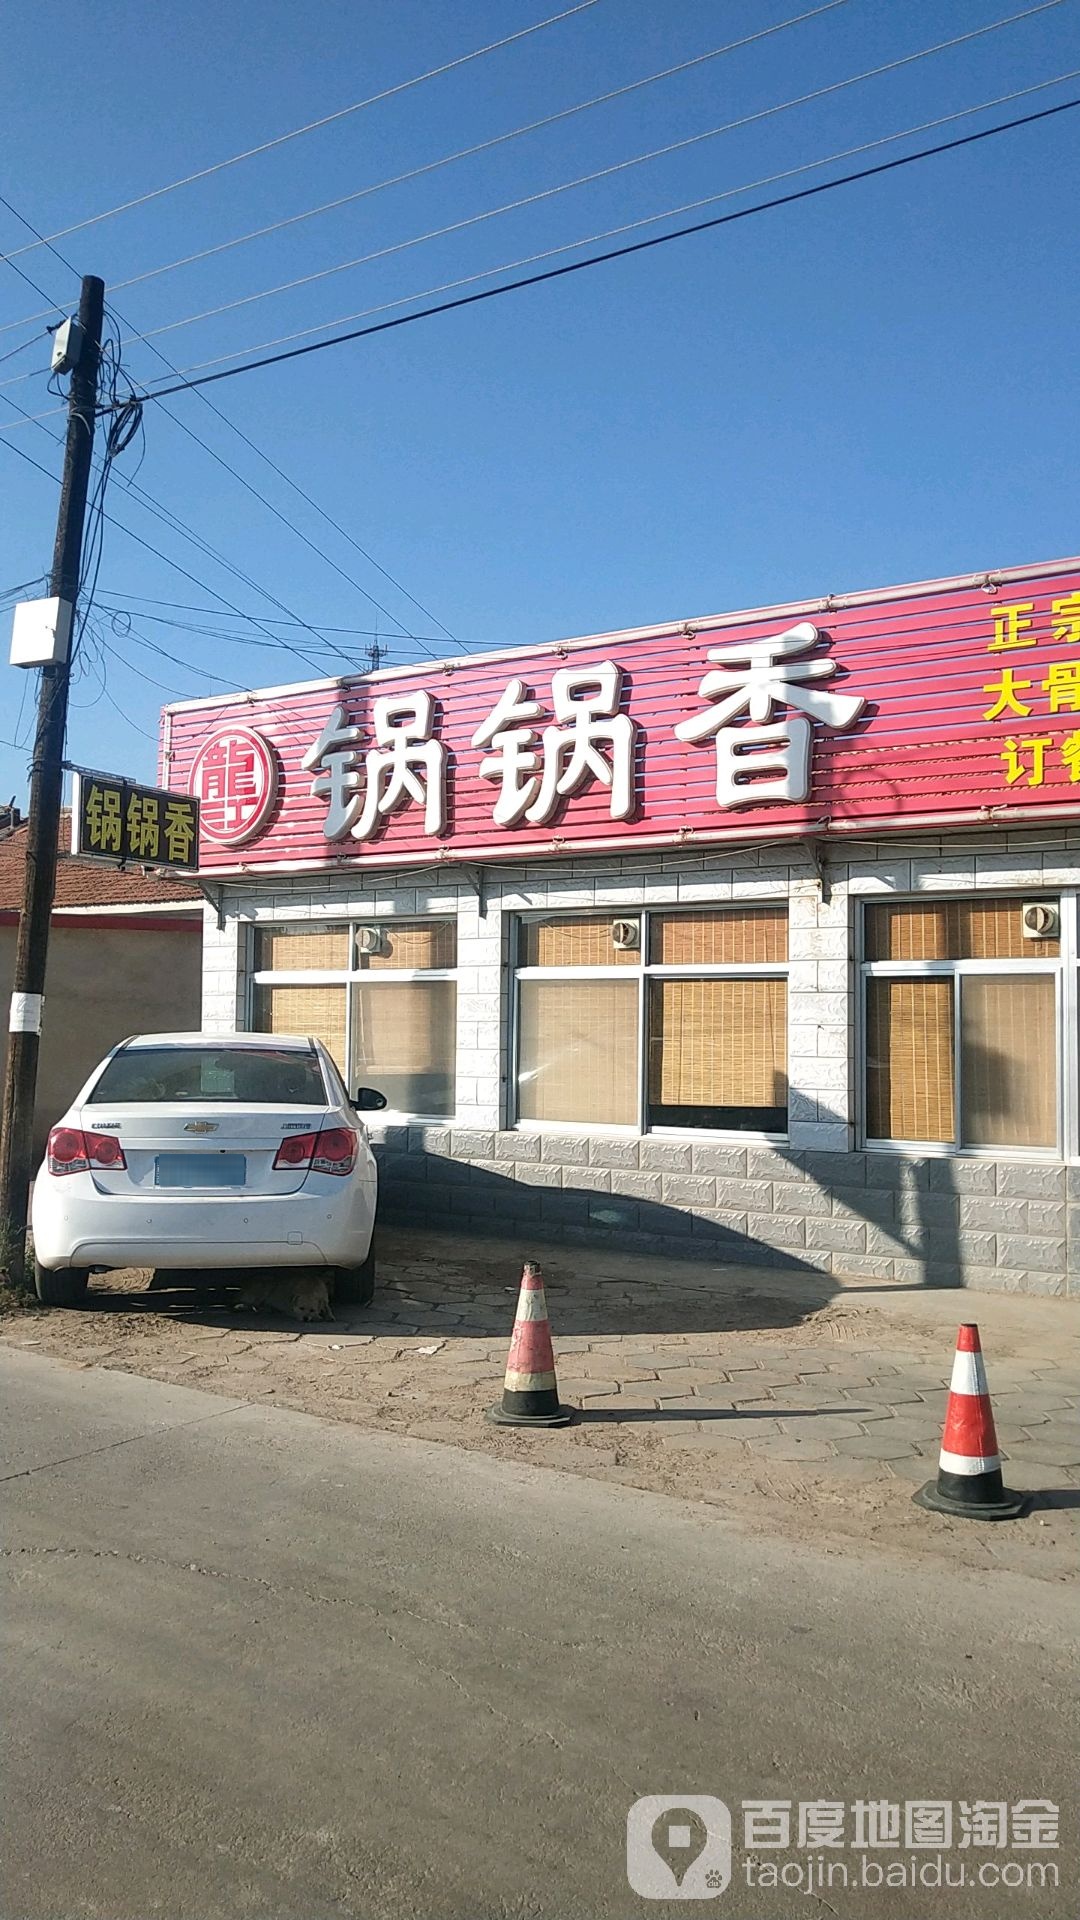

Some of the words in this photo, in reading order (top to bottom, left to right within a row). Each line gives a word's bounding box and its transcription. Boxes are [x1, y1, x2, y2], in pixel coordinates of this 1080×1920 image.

[982, 661, 1080, 721] 大骨
[302, 622, 868, 842] 锅锅香
[86, 784, 195, 863] 锅锅香
